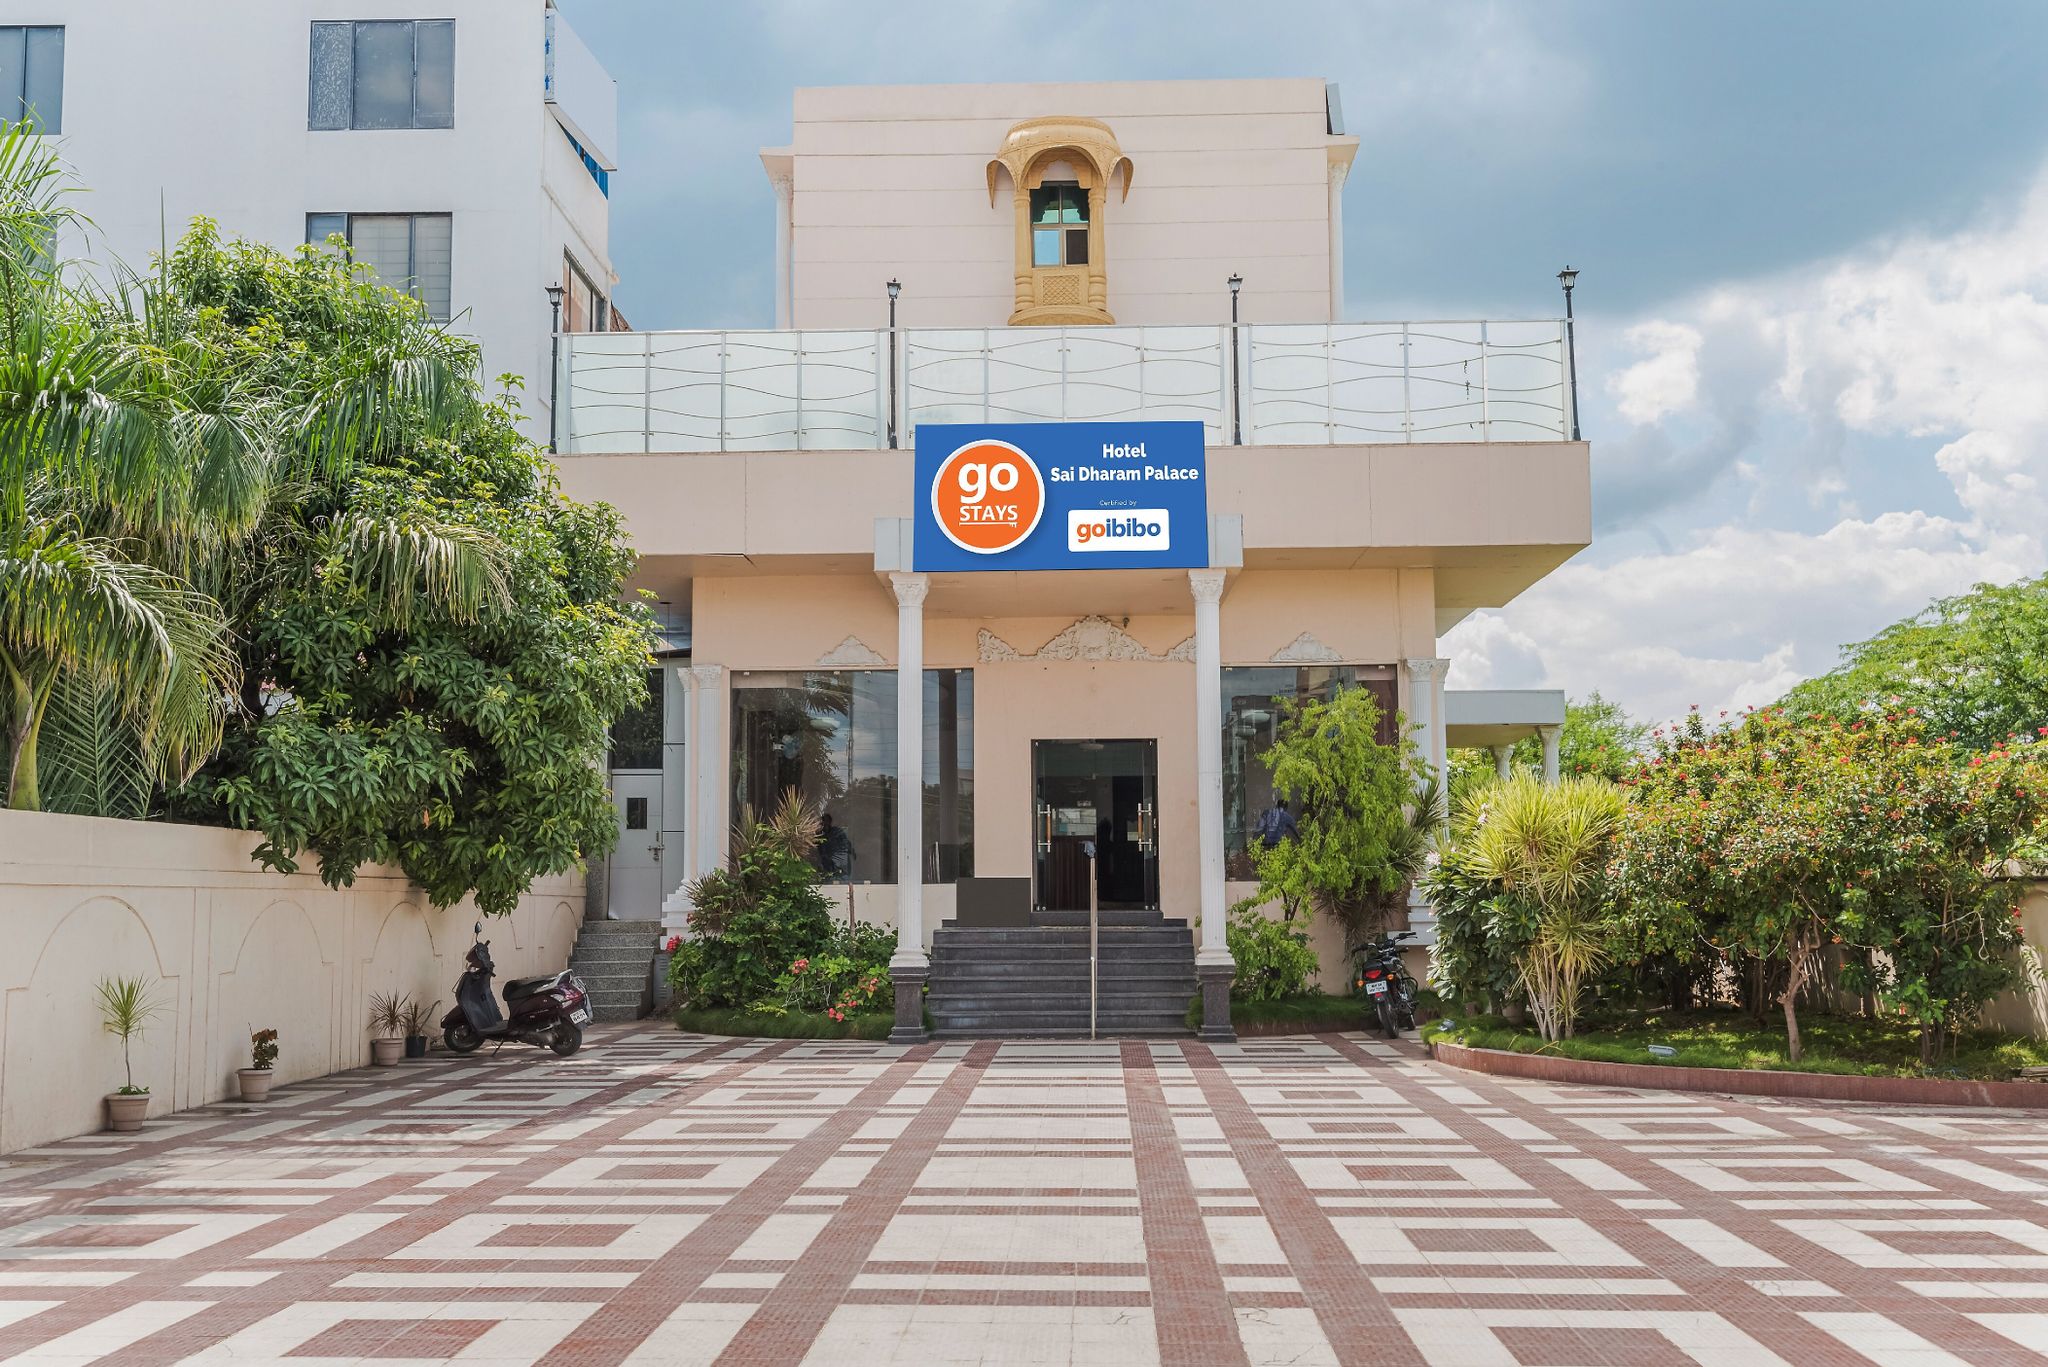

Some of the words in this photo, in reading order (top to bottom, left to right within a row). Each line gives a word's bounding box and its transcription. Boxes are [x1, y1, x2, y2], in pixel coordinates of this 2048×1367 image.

[1102, 443, 1147, 458] Hotel
[1050, 467, 1075, 482] Sai
[1079, 466, 1141, 481] Dharam
[1144, 466, 1199, 481] Palace
[958, 462, 1019, 504] go
[959, 505, 1018, 521] STAYS
[1076, 518, 1161, 543] goibibo
